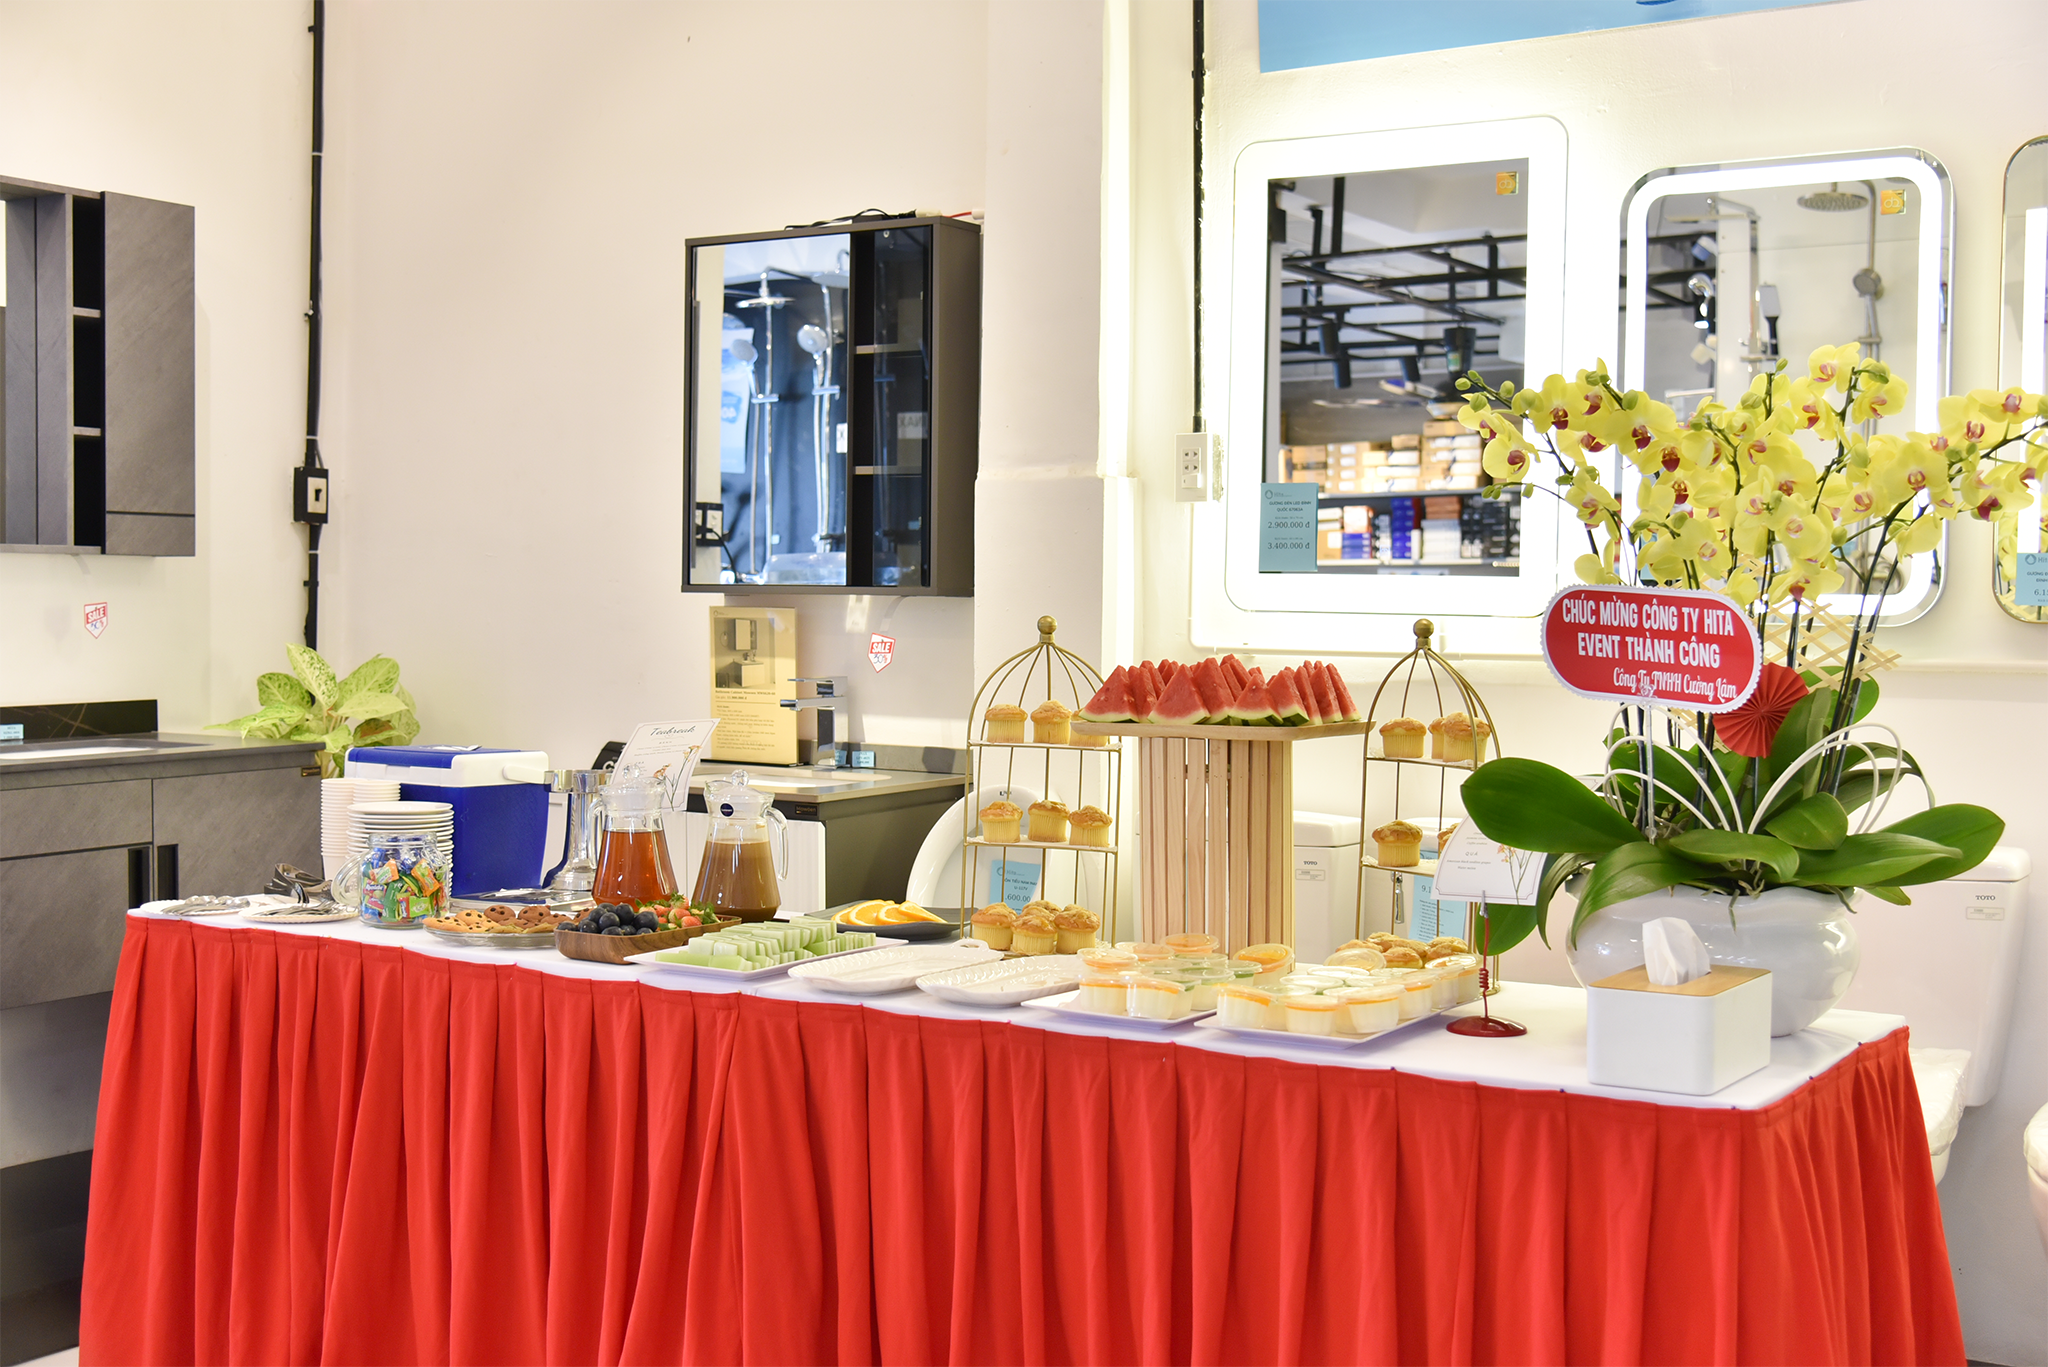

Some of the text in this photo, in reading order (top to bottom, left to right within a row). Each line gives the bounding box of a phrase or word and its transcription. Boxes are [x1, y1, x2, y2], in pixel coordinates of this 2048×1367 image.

[88, 606, 104, 622] SALE
[1562, 594, 1734, 636] CHÚC MỪNG CÔNG TY HITA
[872, 642, 890, 652] SALE
[1578, 632, 1720, 668] EVENT THÀNH CÔNG
[1614, 667, 1737, 703] Công Ty TNHH Cường Lâm
[650, 726, 696, 736] Teabreak
[1005, 894, 1031, 902] .600.00
